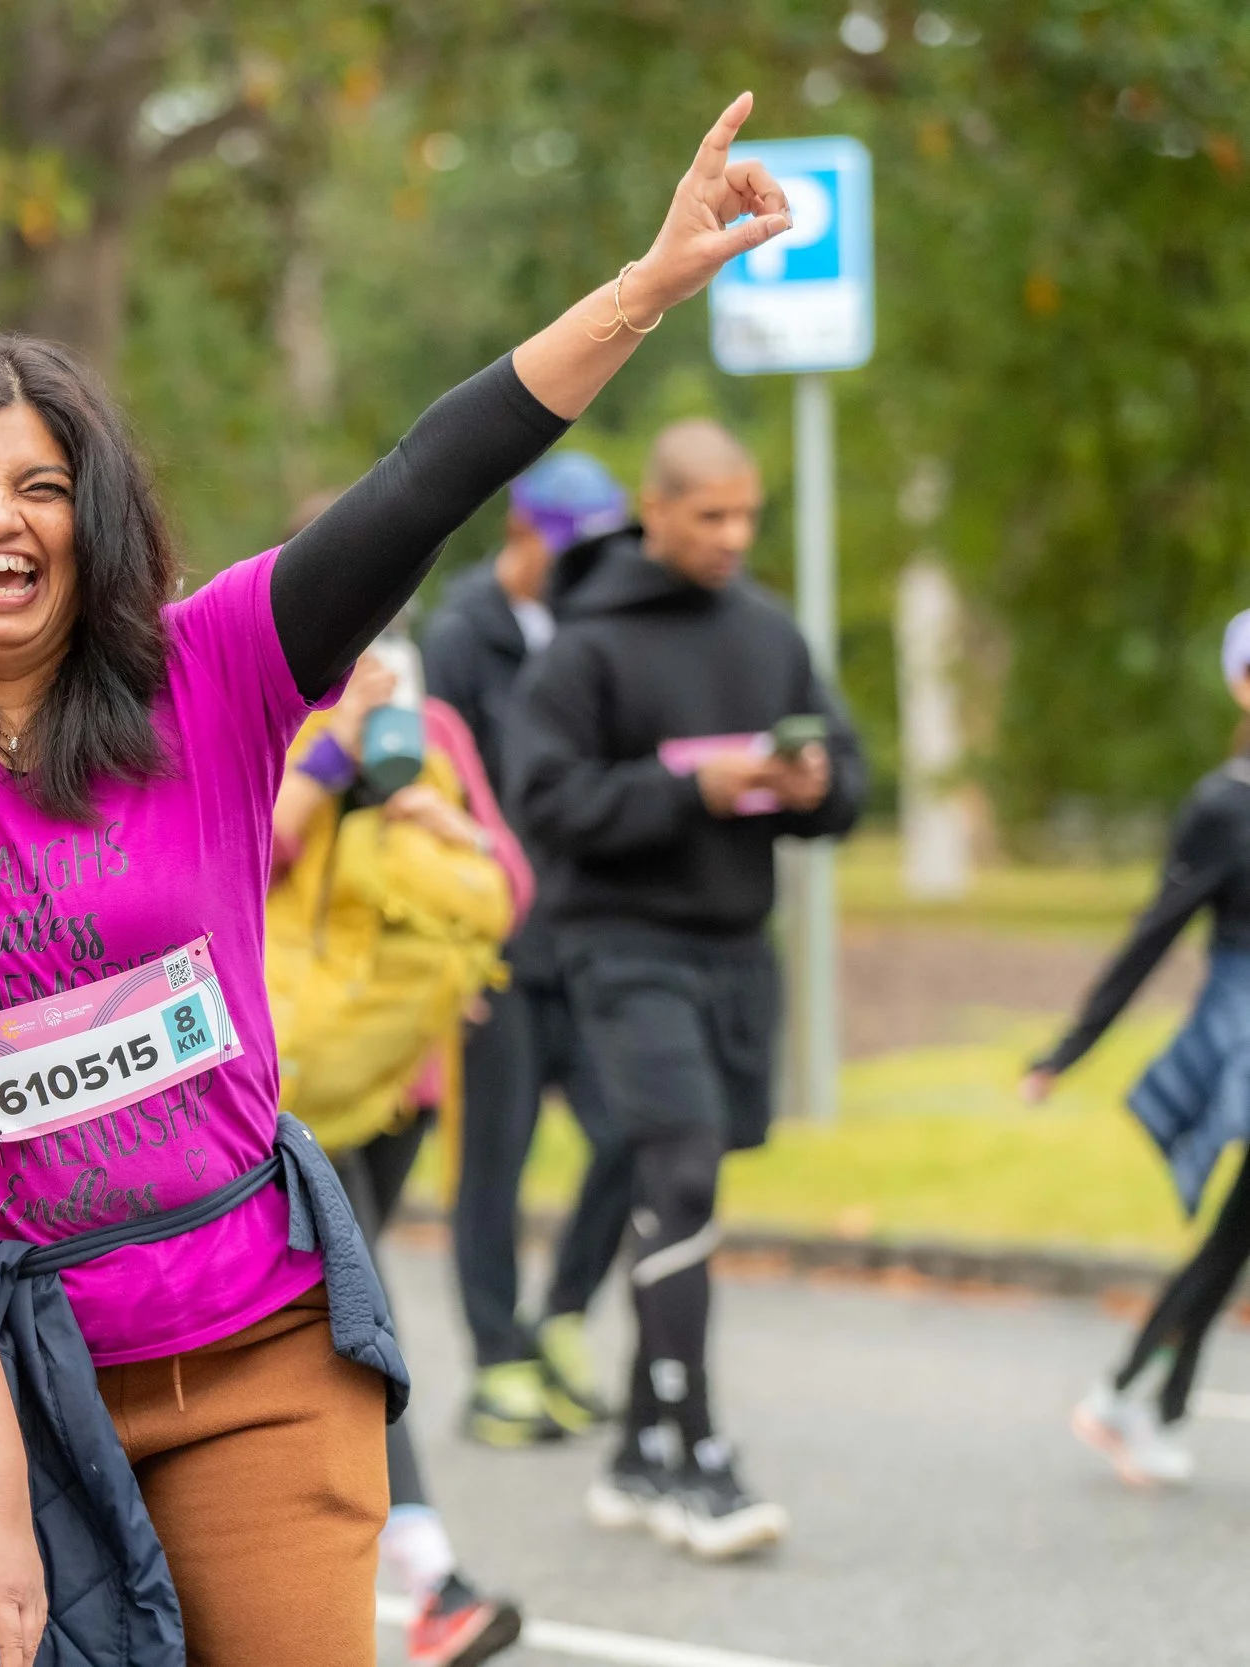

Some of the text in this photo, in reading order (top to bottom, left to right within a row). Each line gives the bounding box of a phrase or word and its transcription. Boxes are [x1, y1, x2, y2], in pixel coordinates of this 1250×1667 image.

[745, 174, 832, 281] P
[174, 1005, 196, 1033] 8
[177, 1028, 207, 1054] KM
[0, 1166, 163, 1229] Endless
